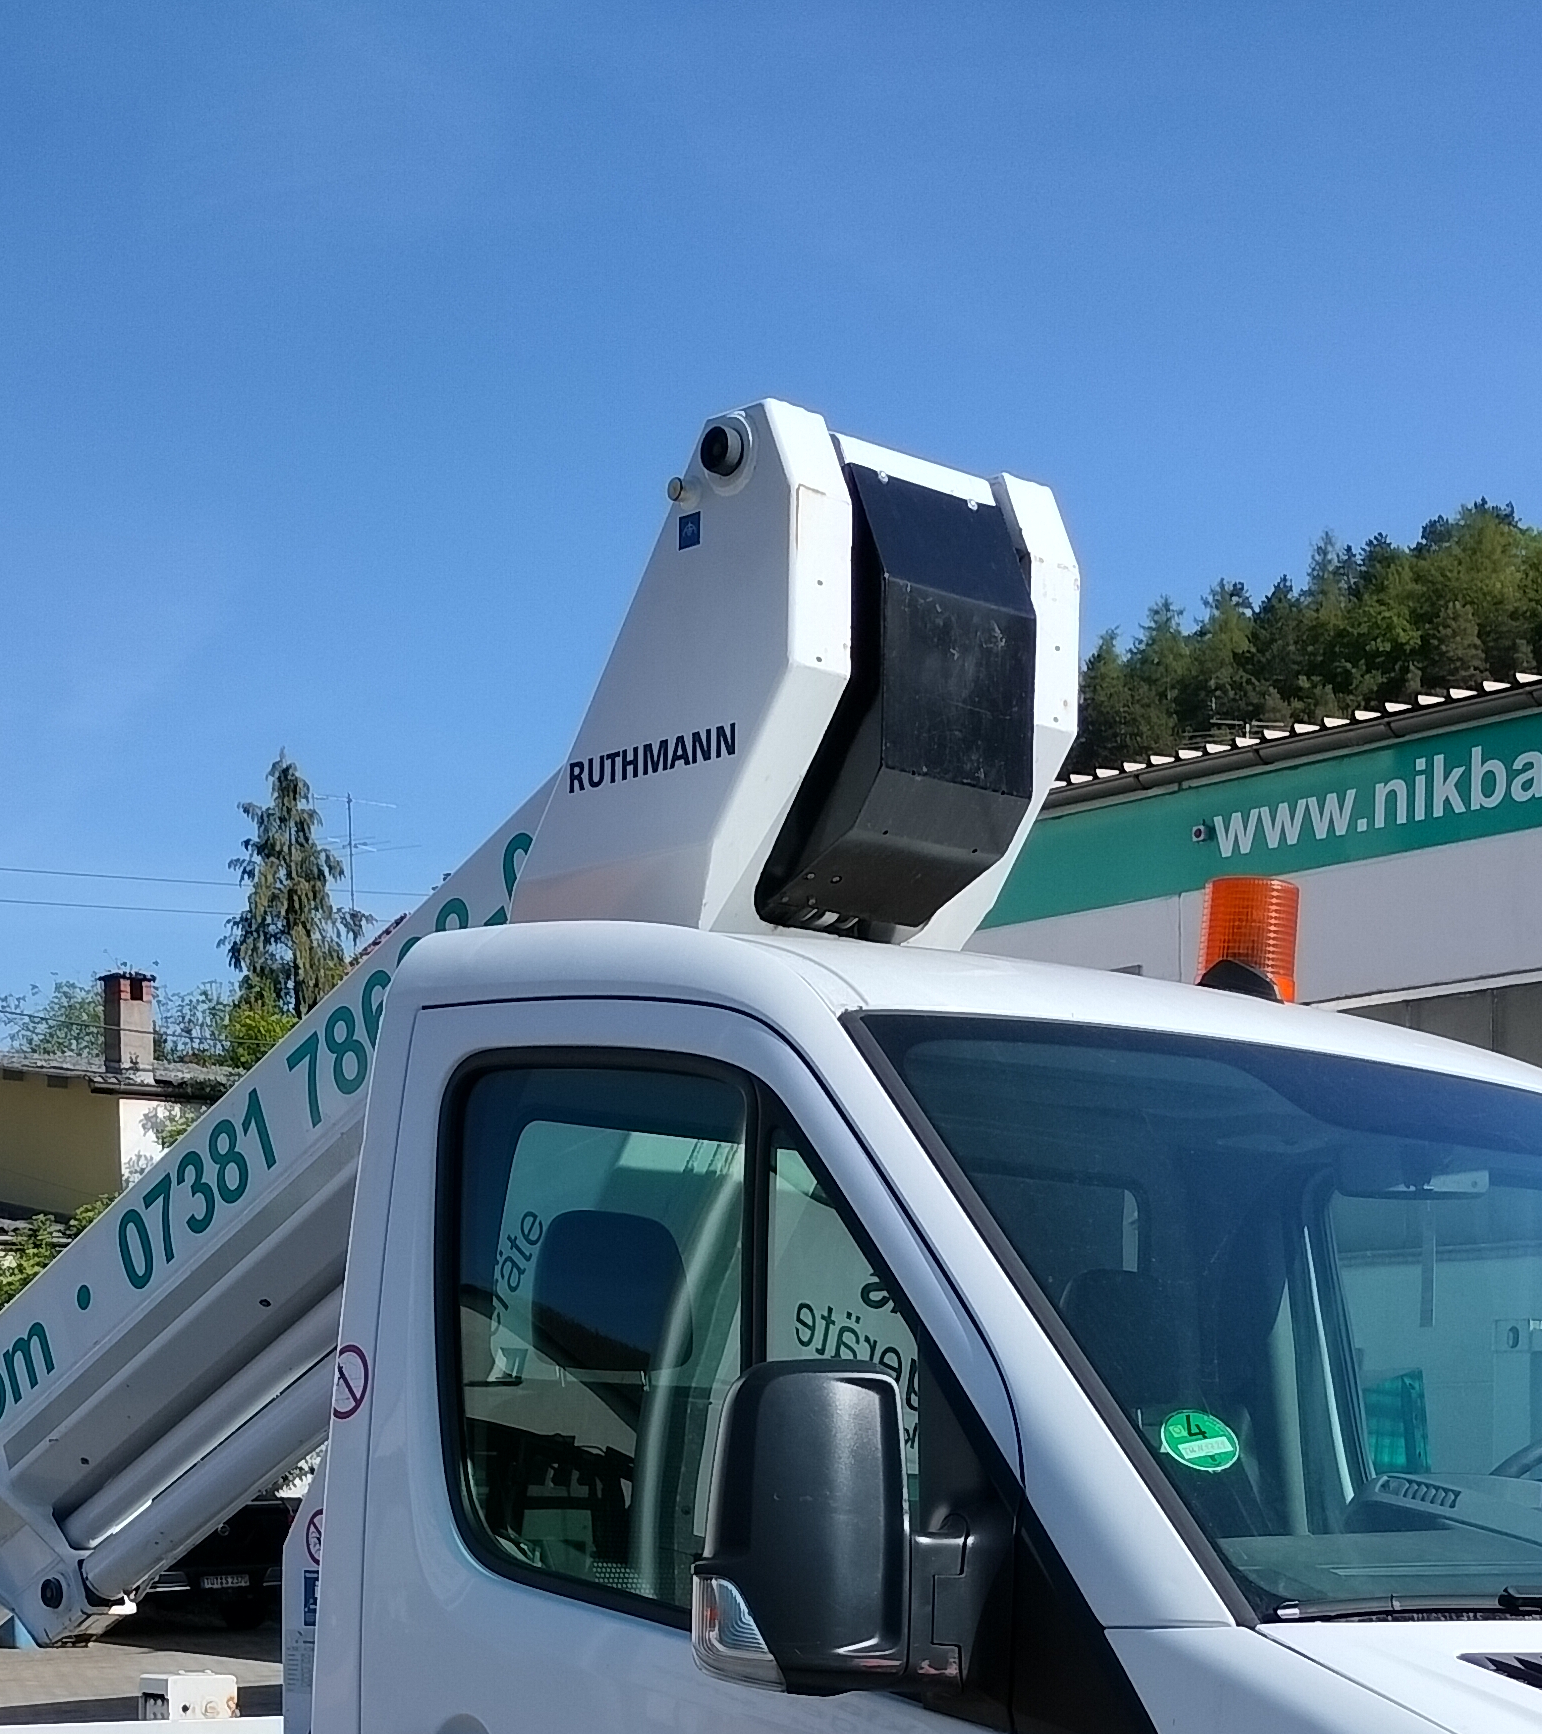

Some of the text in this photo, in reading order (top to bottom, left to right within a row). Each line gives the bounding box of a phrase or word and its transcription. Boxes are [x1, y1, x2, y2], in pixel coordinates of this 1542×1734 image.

[569, 722, 737, 794] RUTHMANN
[118, 1087, 277, 1290] 07381
[1185, 1414, 1208, 1439] 4
